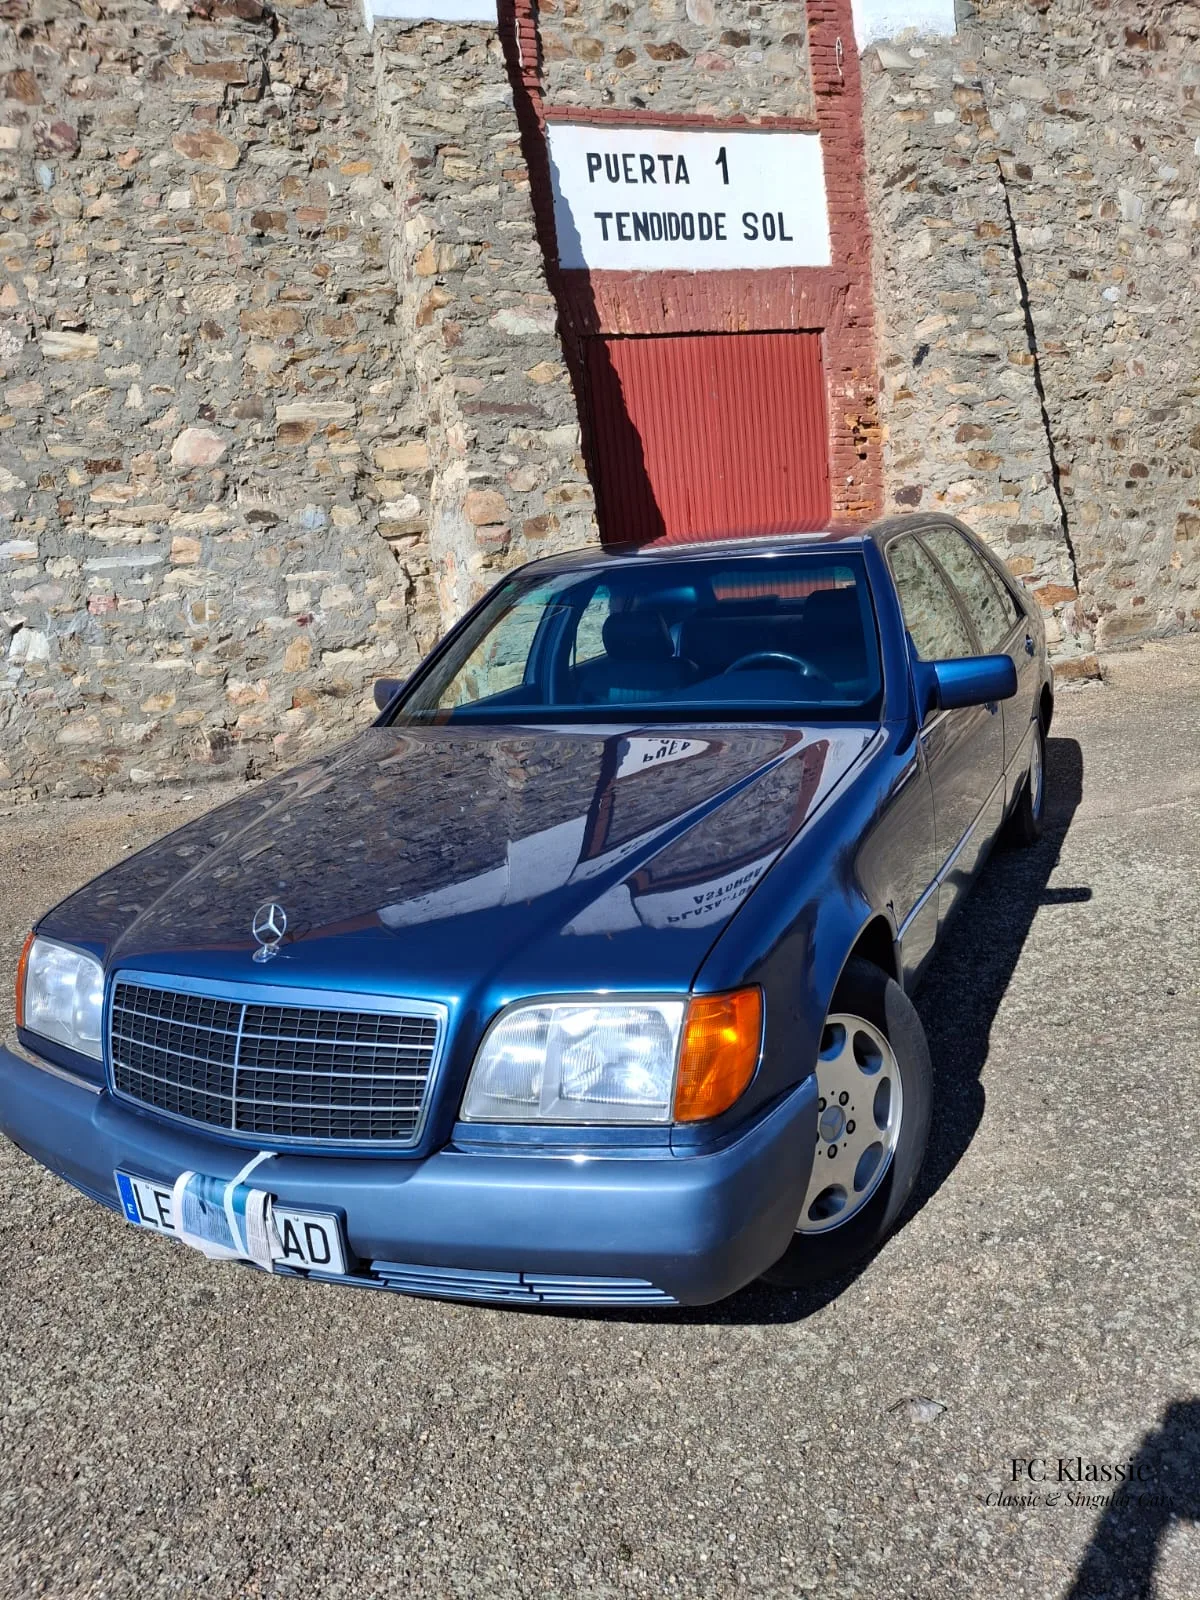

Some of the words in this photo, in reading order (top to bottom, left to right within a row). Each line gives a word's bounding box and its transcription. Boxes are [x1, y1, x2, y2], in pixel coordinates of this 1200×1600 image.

[586, 152, 690, 184] PUERTA
[715, 146, 730, 185] 1
[742, 211, 793, 241] SOL
[284, 1219, 331, 1264] AD
